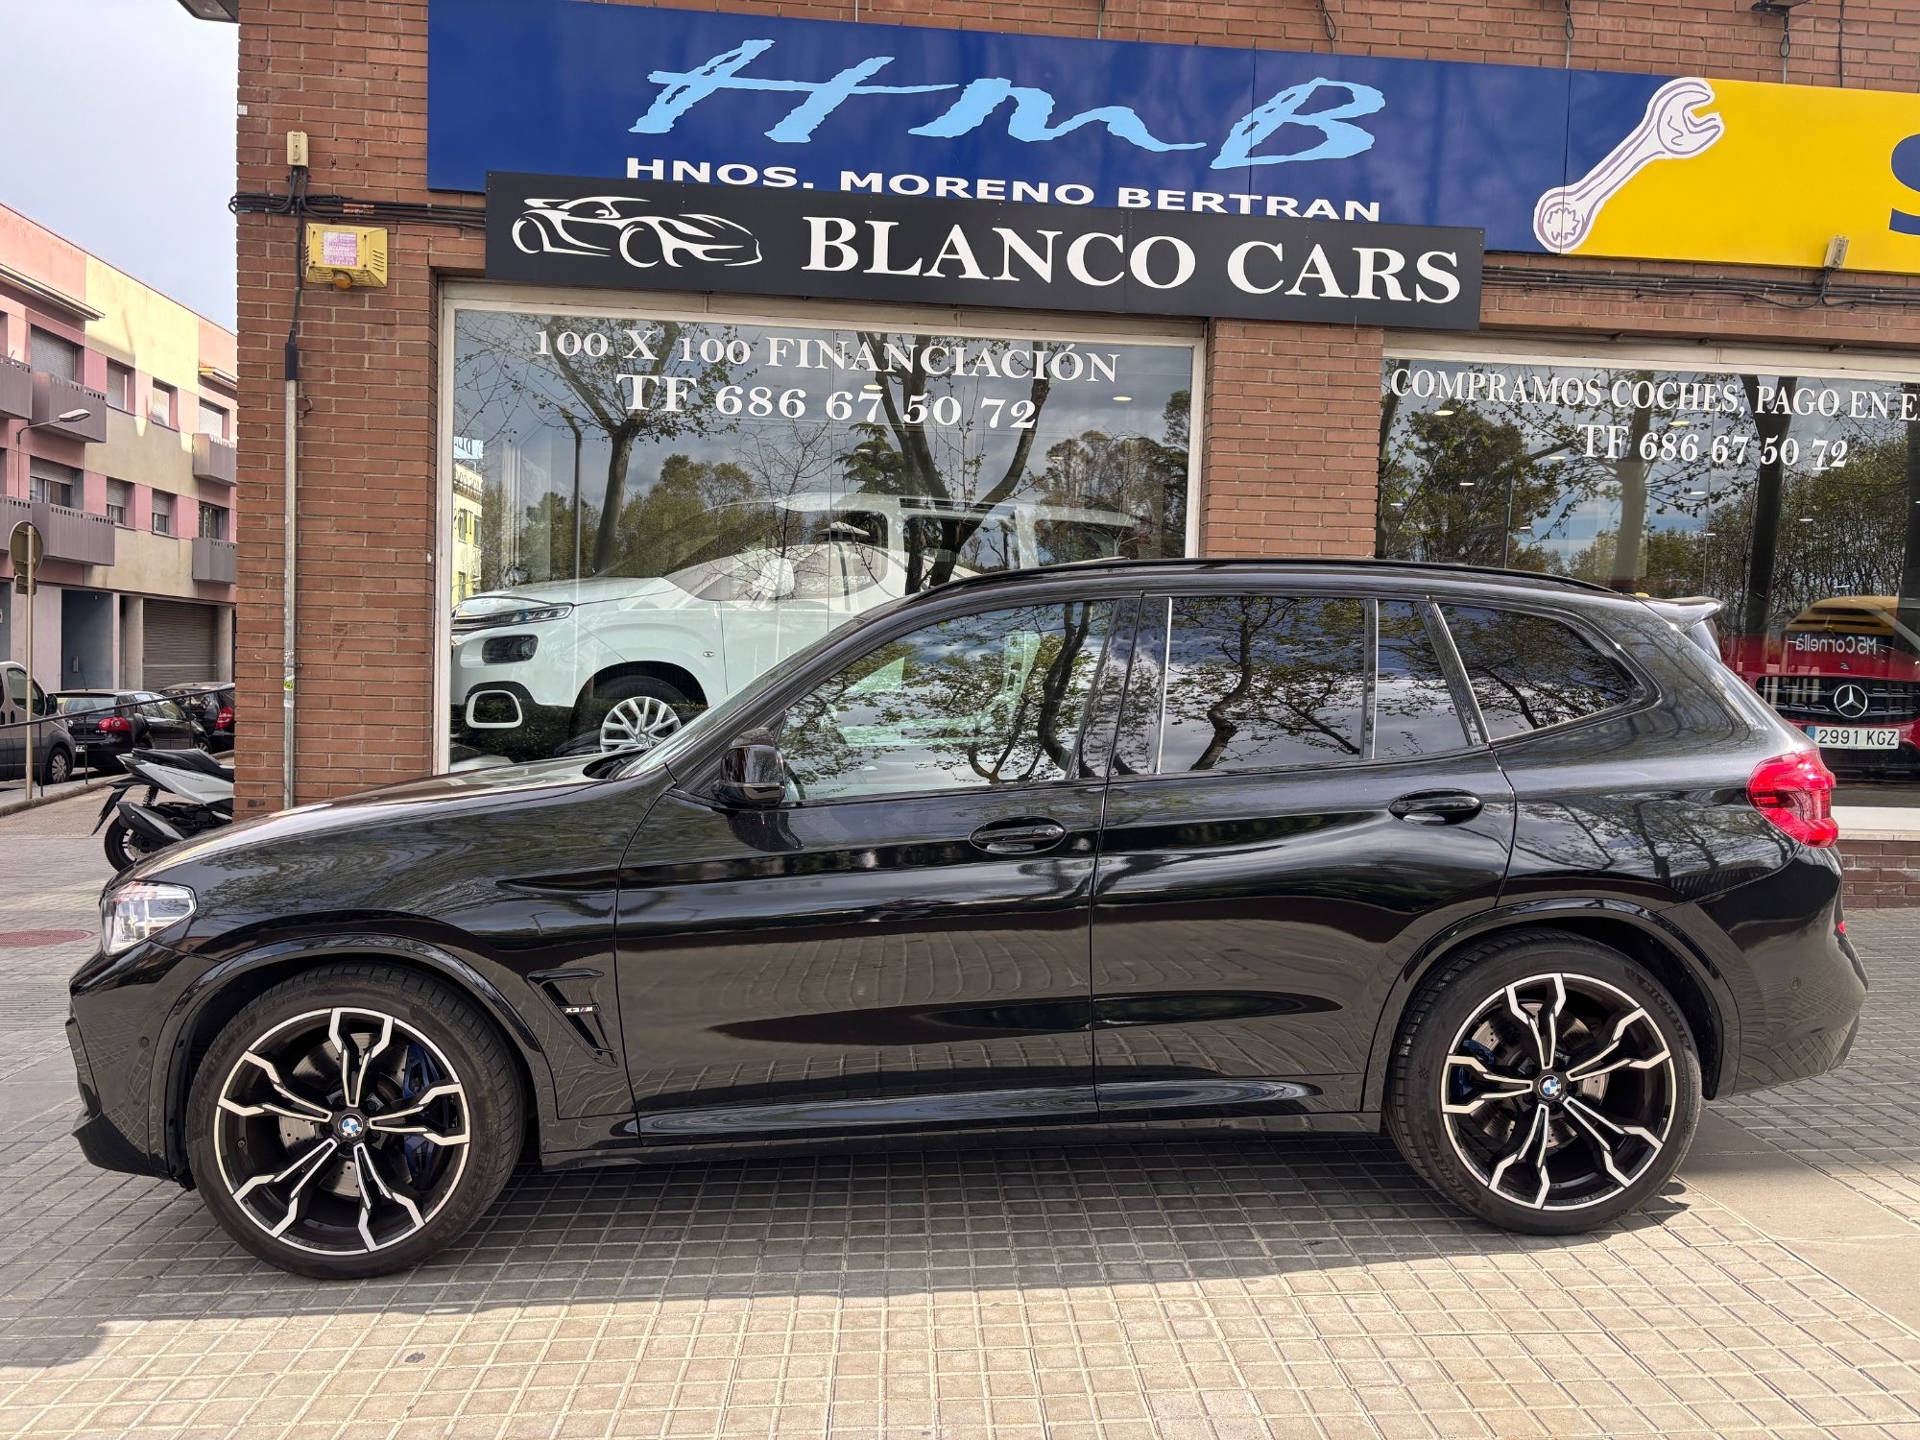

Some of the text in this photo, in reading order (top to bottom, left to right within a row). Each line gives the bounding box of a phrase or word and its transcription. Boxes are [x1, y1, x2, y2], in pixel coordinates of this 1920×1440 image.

[627, 157, 1379, 221] HNOS. MORENO BERTRAN
[802, 217, 1460, 303] BLANCO CARS
[535, 330, 1120, 383] 100 X 100 FINANCIACIÓN
[616, 374, 1035, 428] TF 686 67 50 72
[1391, 369, 1920, 421] COMPRAMOS COCHES, PAGO EN E
[1577, 424, 1847, 470] TF 686 67 50 72
[1818, 729, 1897, 746] 2991 KGZ
